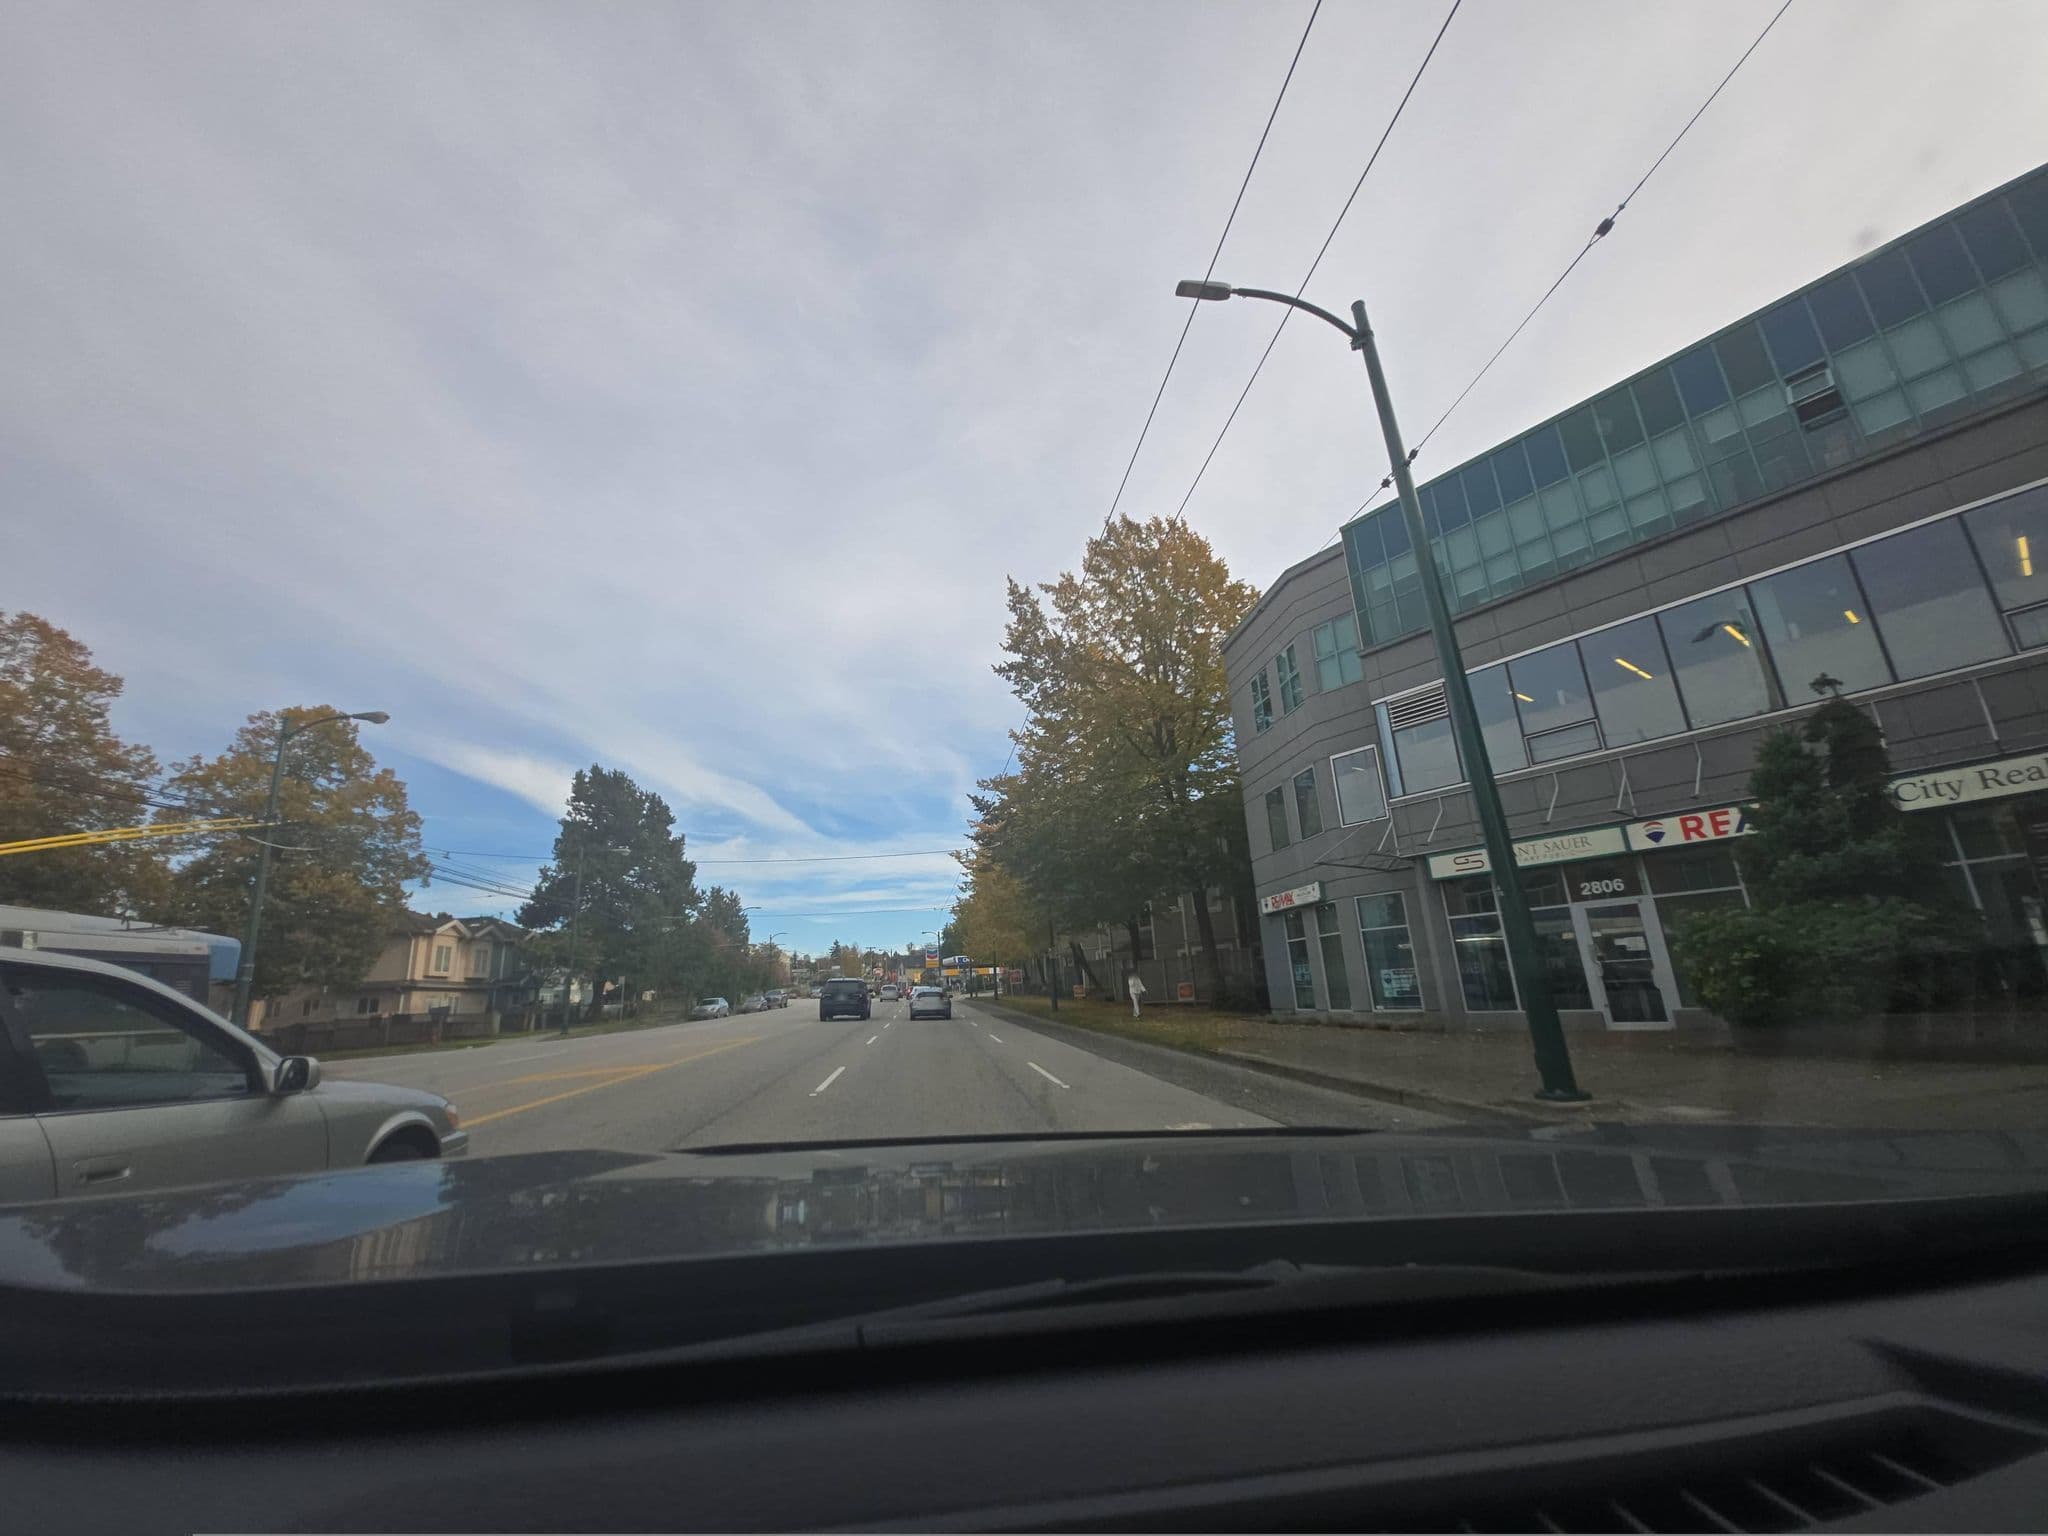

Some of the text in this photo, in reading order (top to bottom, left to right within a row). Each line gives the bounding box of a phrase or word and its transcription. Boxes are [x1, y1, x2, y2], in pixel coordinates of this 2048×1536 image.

[1895, 779, 1964, 802] City
[1543, 836, 1593, 851] SAUER
[1580, 878, 1625, 896] 2806
